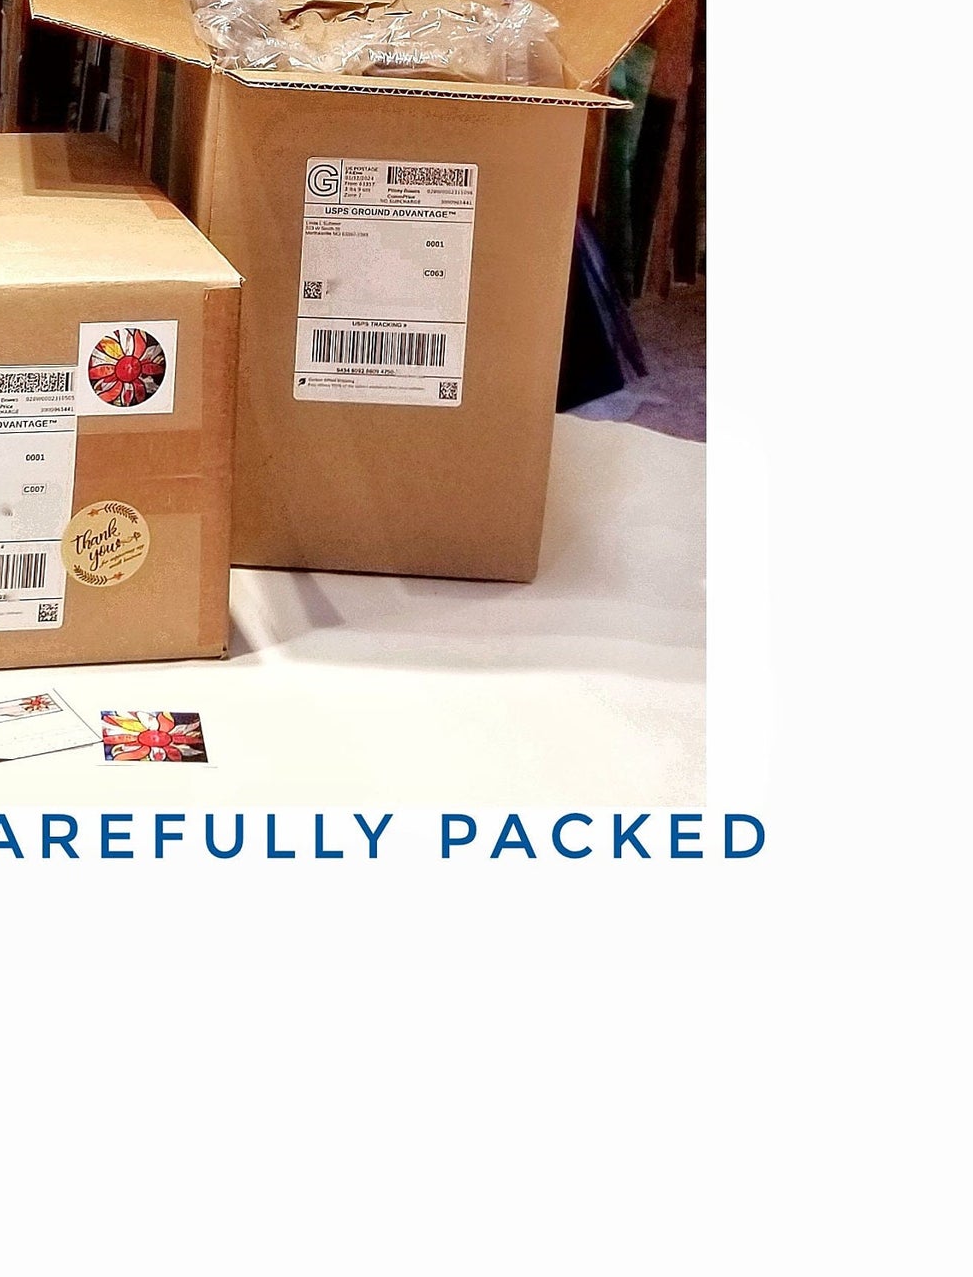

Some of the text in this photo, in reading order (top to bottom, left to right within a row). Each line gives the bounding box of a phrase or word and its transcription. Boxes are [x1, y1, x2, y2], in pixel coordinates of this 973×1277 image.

[308, 164, 339, 196] G
[325, 207, 349, 215] USPS
[351, 208, 390, 216] GROUND
[426, 240, 444, 248] 0001
[424, 269, 444, 277] C063
[25, 453, 45, 461] 0001
[23, 485, 45, 493] C007
[70, 517, 121, 554] thank
